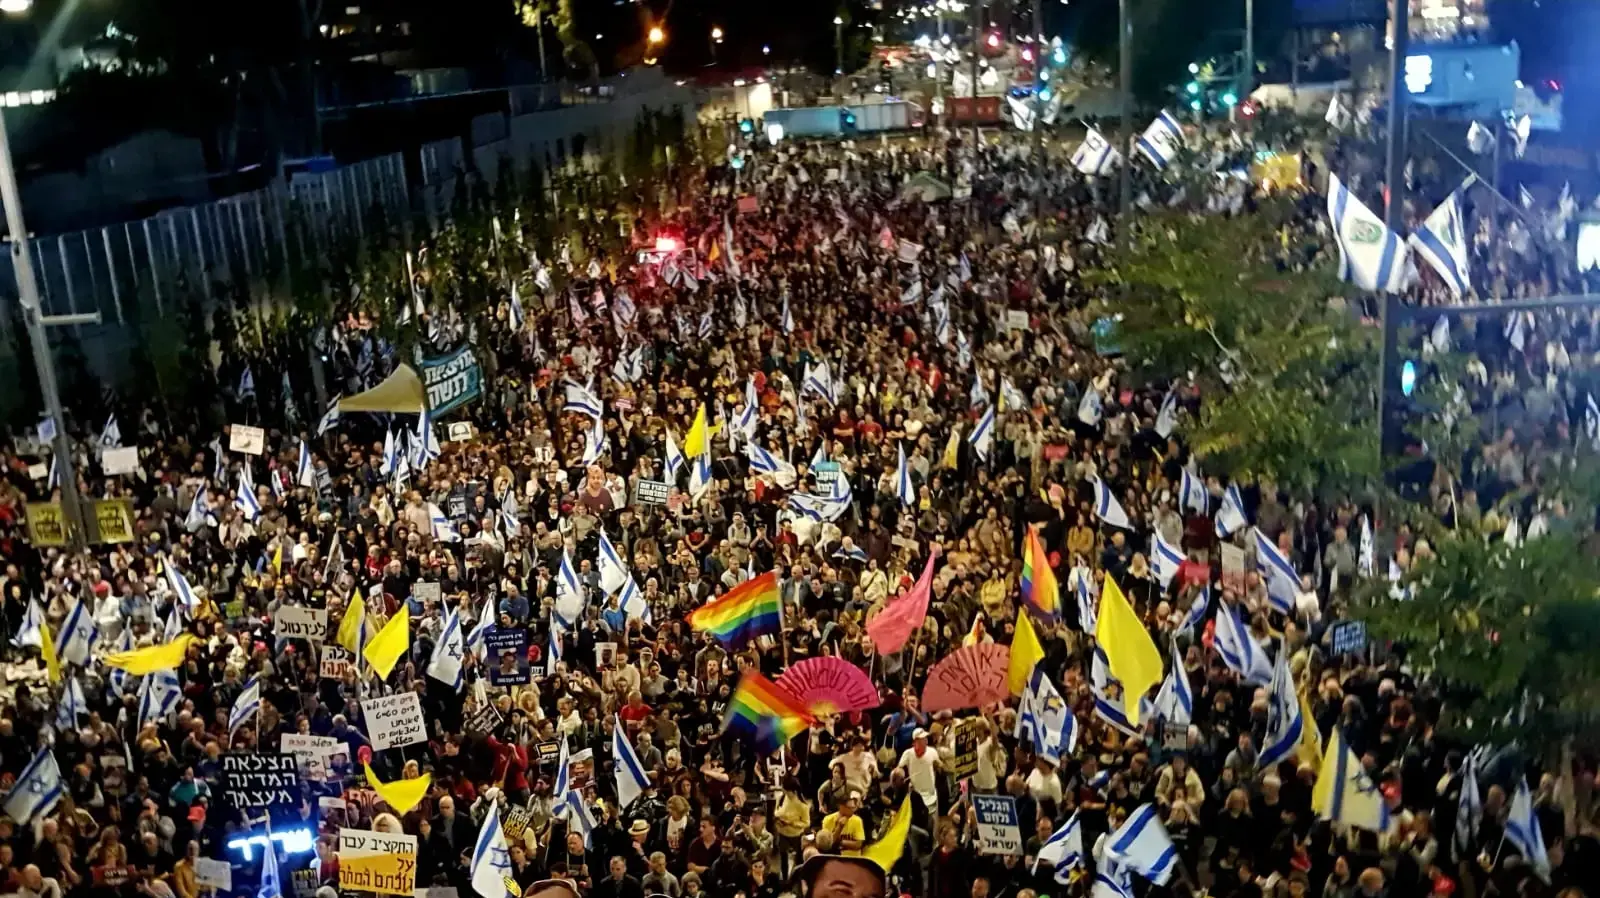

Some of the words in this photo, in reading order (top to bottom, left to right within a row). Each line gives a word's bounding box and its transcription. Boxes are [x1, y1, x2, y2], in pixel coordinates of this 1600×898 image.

[228, 773, 296, 787] המדינה
[978, 798, 1009, 812] הגליל
[983, 812, 1010, 824] נלחם
[992, 825, 1006, 837] על
[341, 836, 366, 849] עבר
[370, 838, 414, 854] התקציב
[984, 836, 1018, 850] ישראל
[397, 857, 414, 872] על
